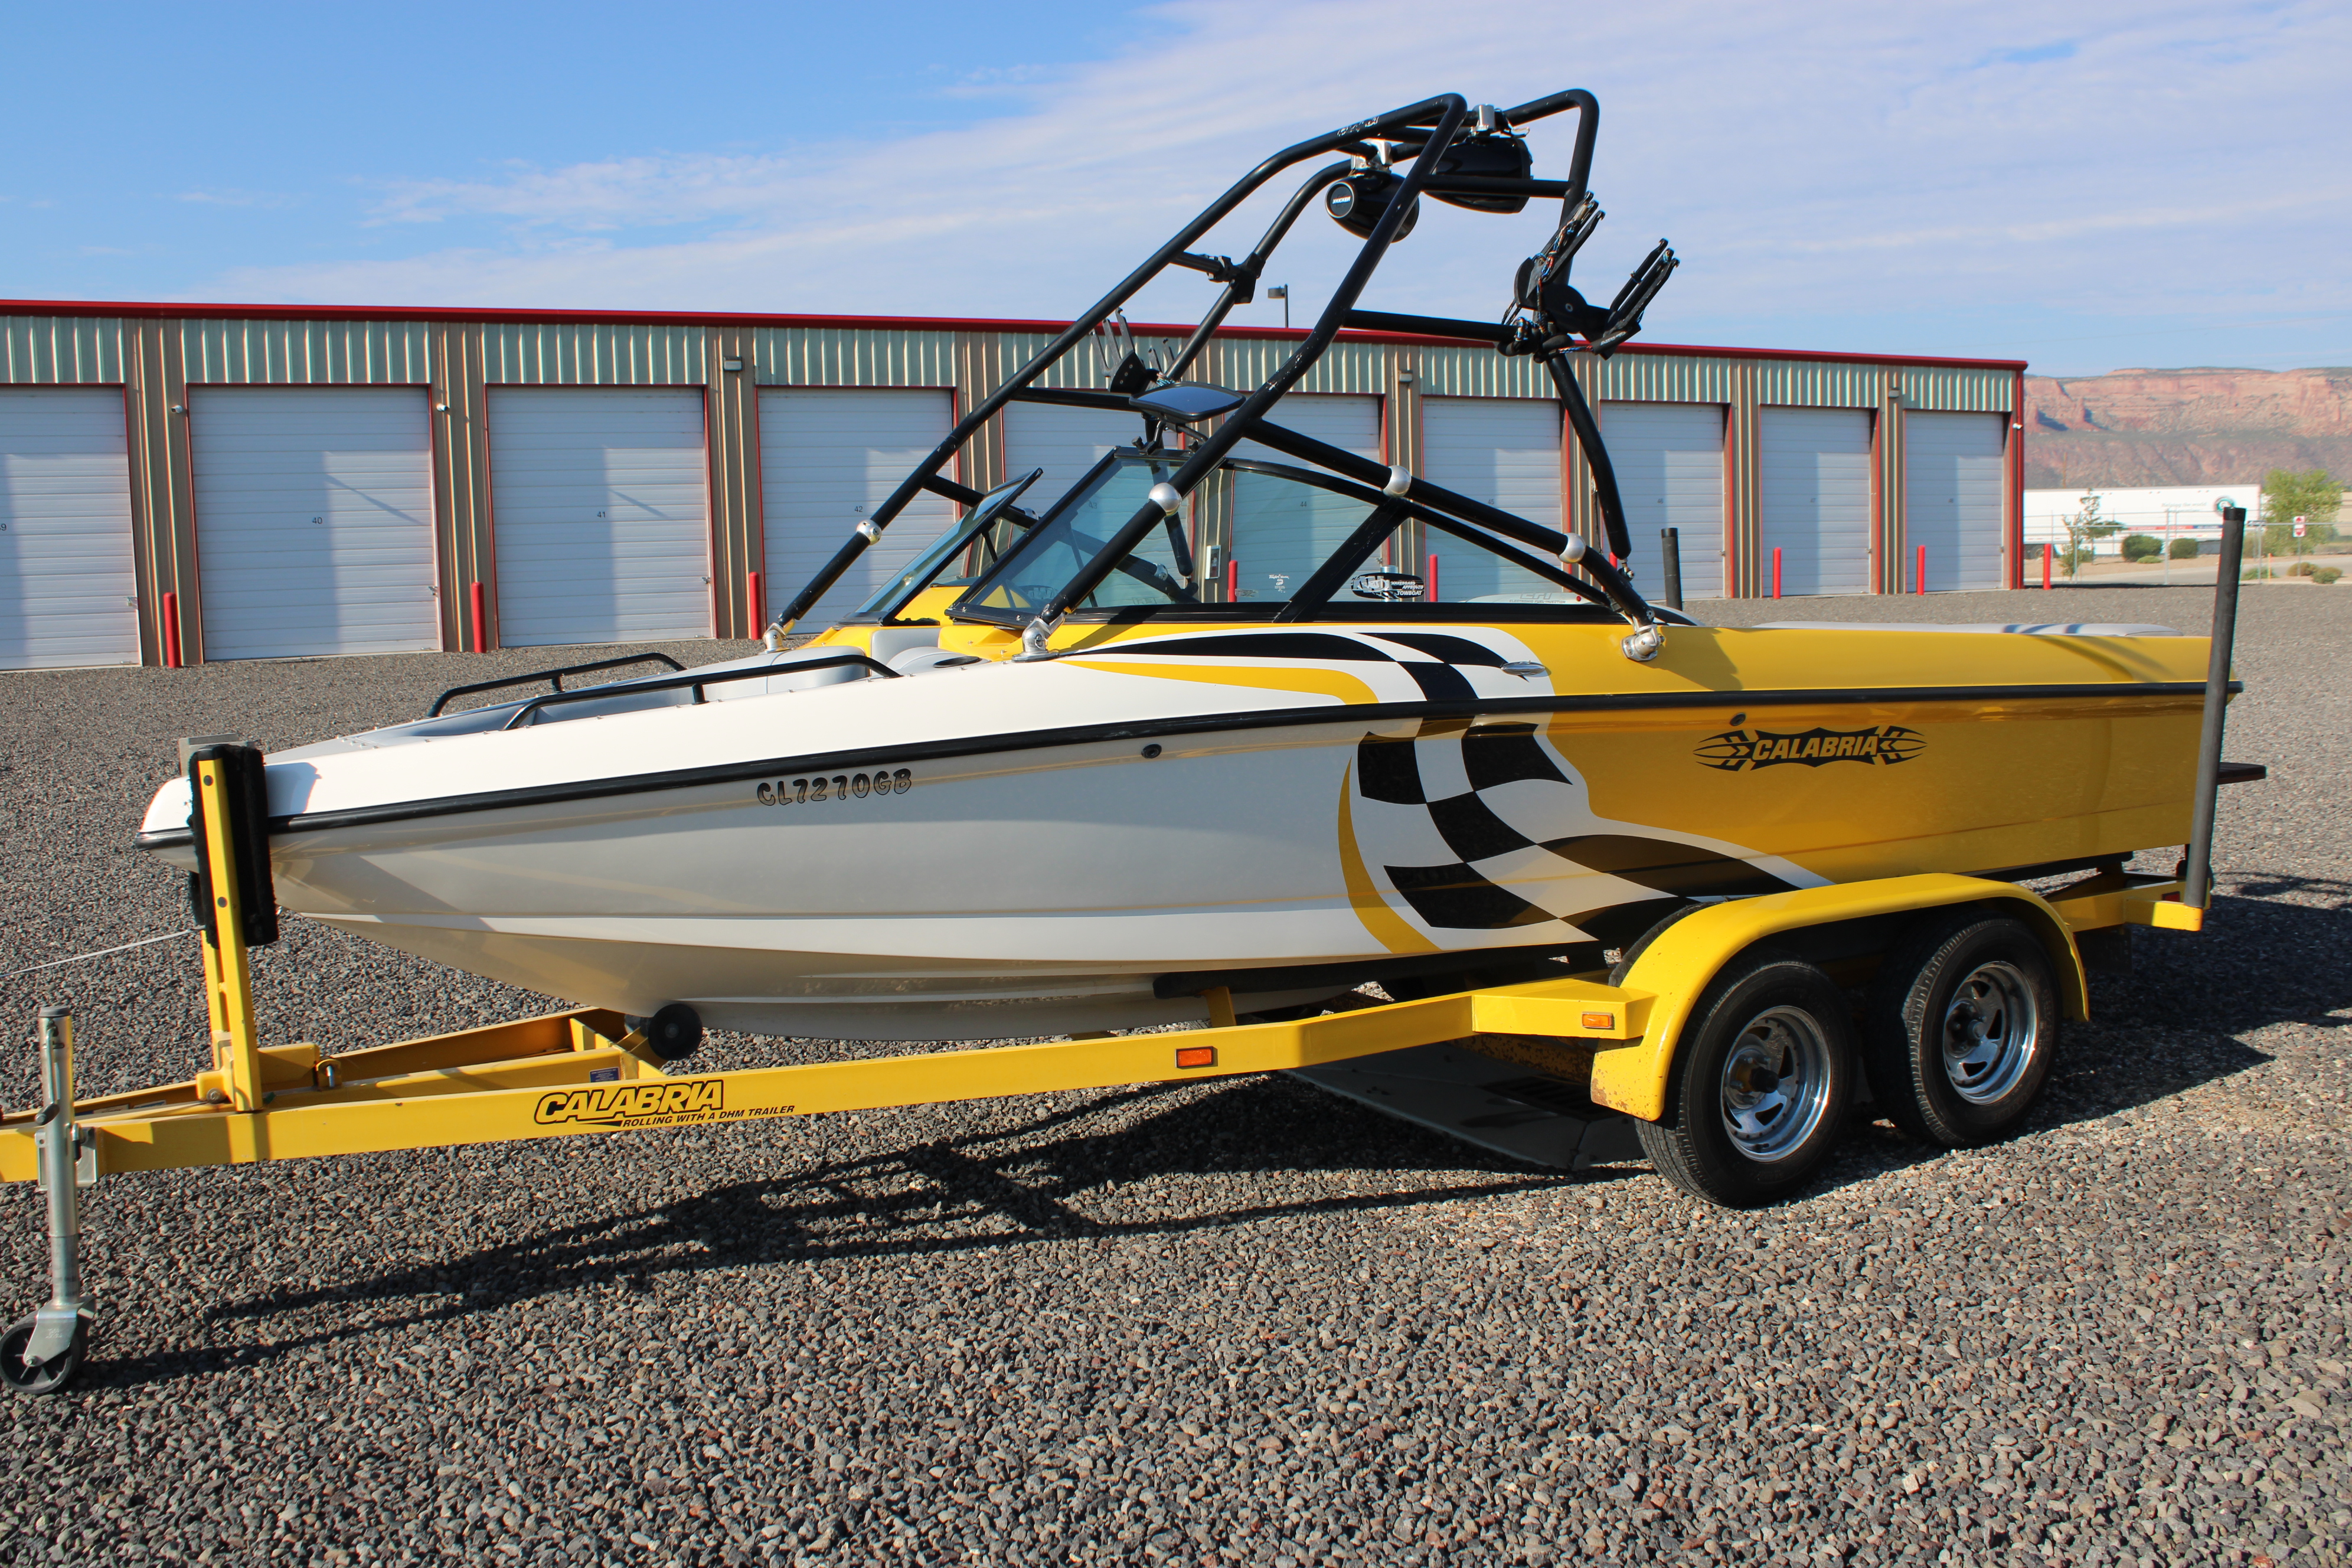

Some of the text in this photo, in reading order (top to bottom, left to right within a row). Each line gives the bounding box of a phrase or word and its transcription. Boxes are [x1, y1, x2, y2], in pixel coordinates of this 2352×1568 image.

[1333, 195, 1351, 204] KICKER
[0, 523, 6, 531] 9
[1752, 736, 1880, 761] CALABRIA
[534, 1079, 724, 1125] CALABRIA
[622, 1105, 795, 1128] ROLLING WITH A DHM TRAILER
